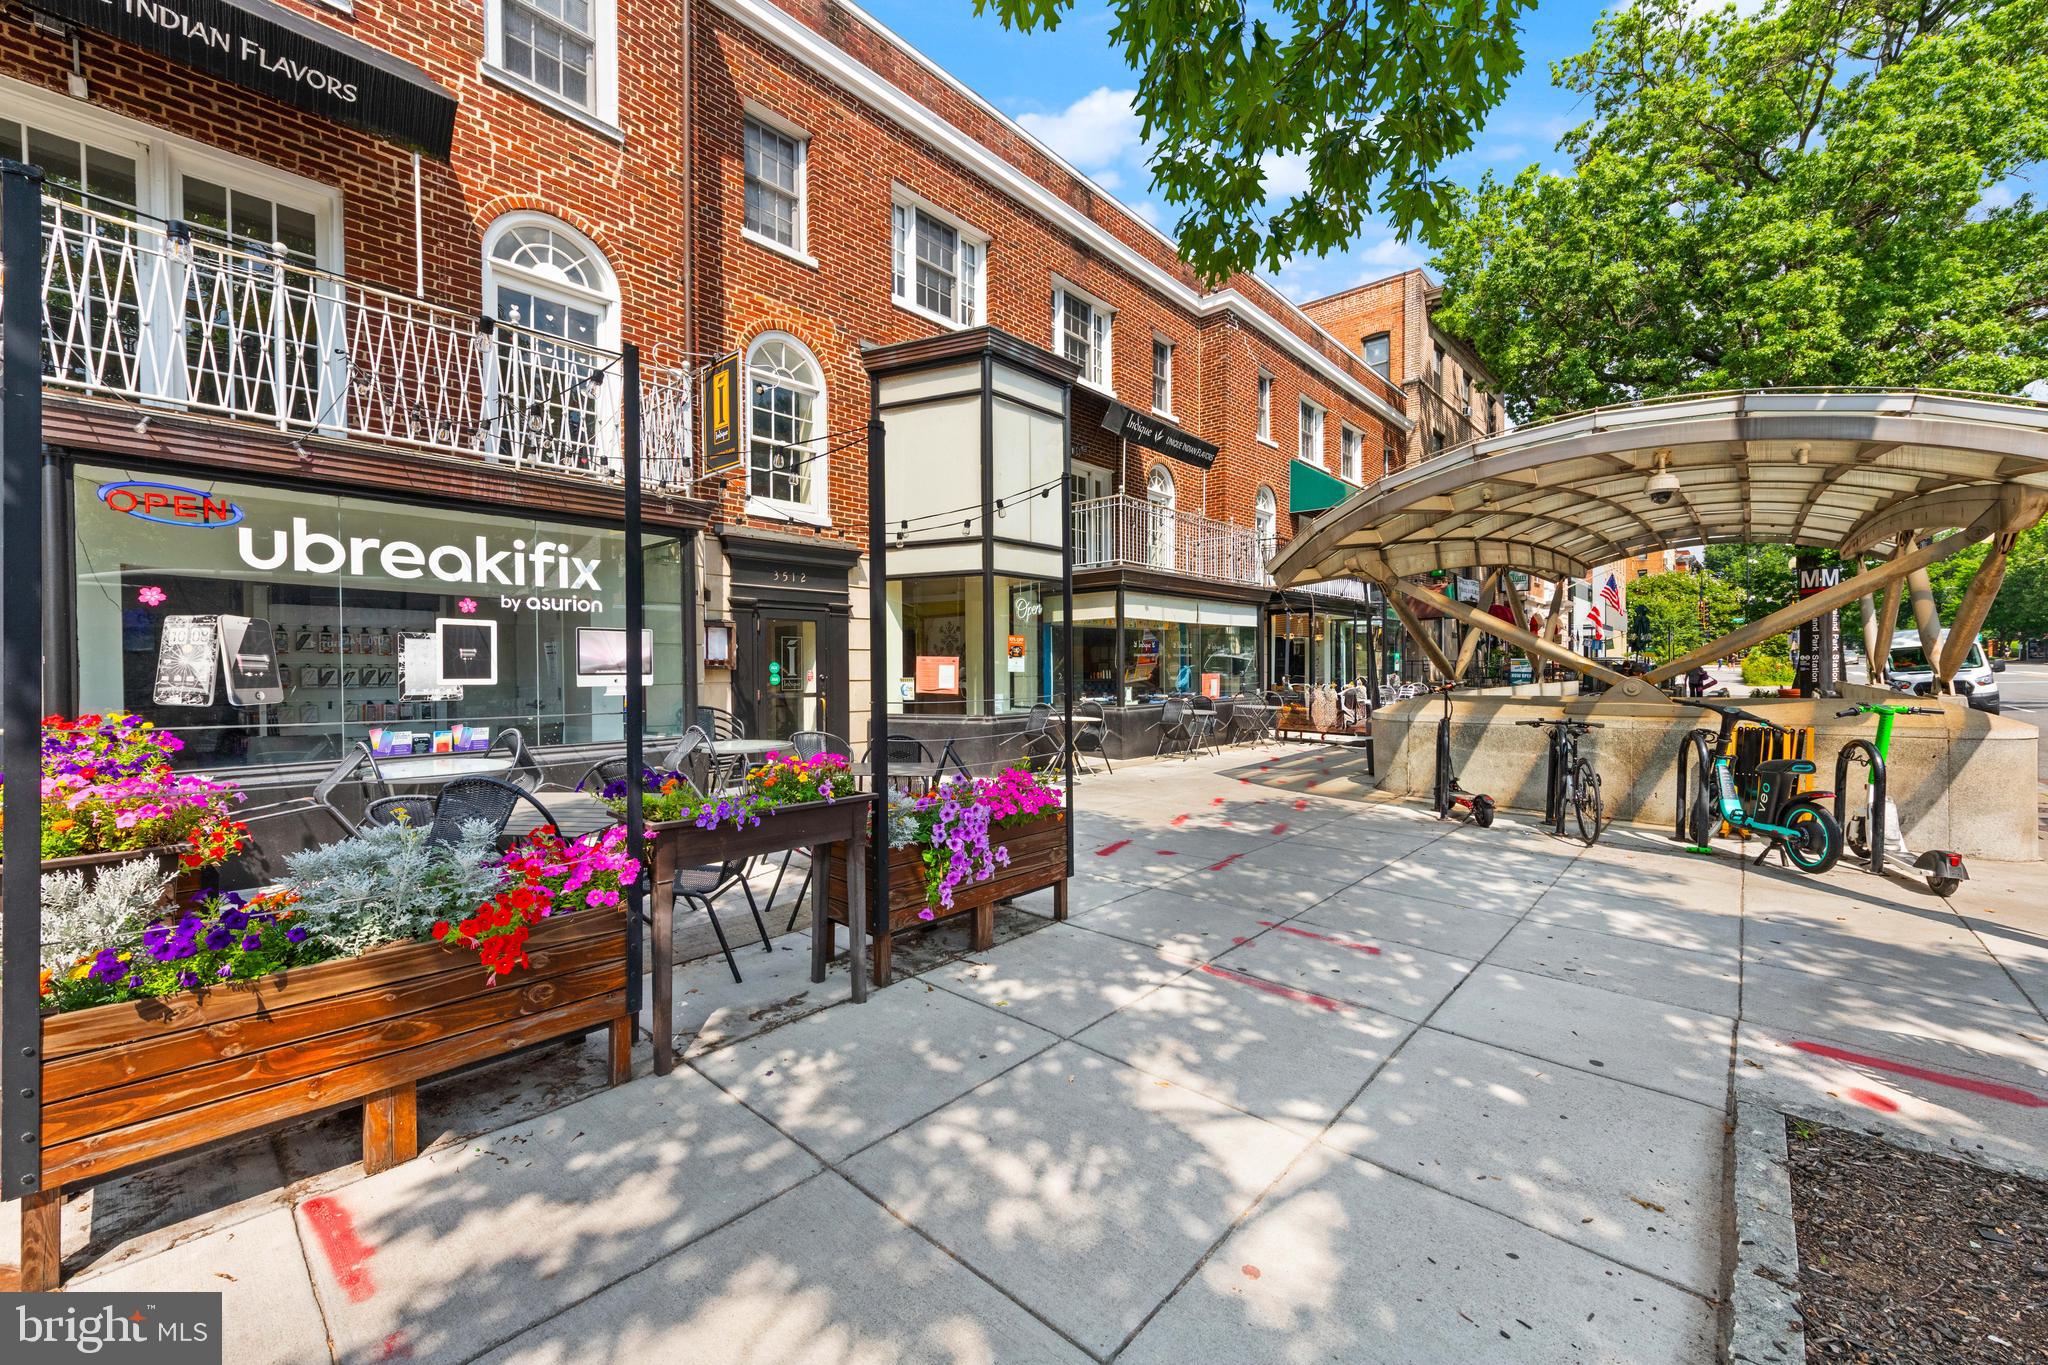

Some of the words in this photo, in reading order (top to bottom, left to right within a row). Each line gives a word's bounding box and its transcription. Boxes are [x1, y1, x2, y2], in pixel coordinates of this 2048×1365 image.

[239, 36, 358, 103] FLAVORS
[1126, 413, 1153, 439] Indique
[106, 489, 227, 521] OPEN
[238, 517, 602, 591] ubreakifix
[773, 570, 806, 583] 3512
[500, 595, 522, 612] by
[526, 596, 603, 613] asurion
[1015, 598, 1043, 622] Open
[1811, 634, 1820, 651] Park
[1832, 634, 1840, 651] Park
[1811, 655, 1820, 683] Station
[1832, 655, 1840, 683] Station
[1758, 782, 1771, 812] veo
